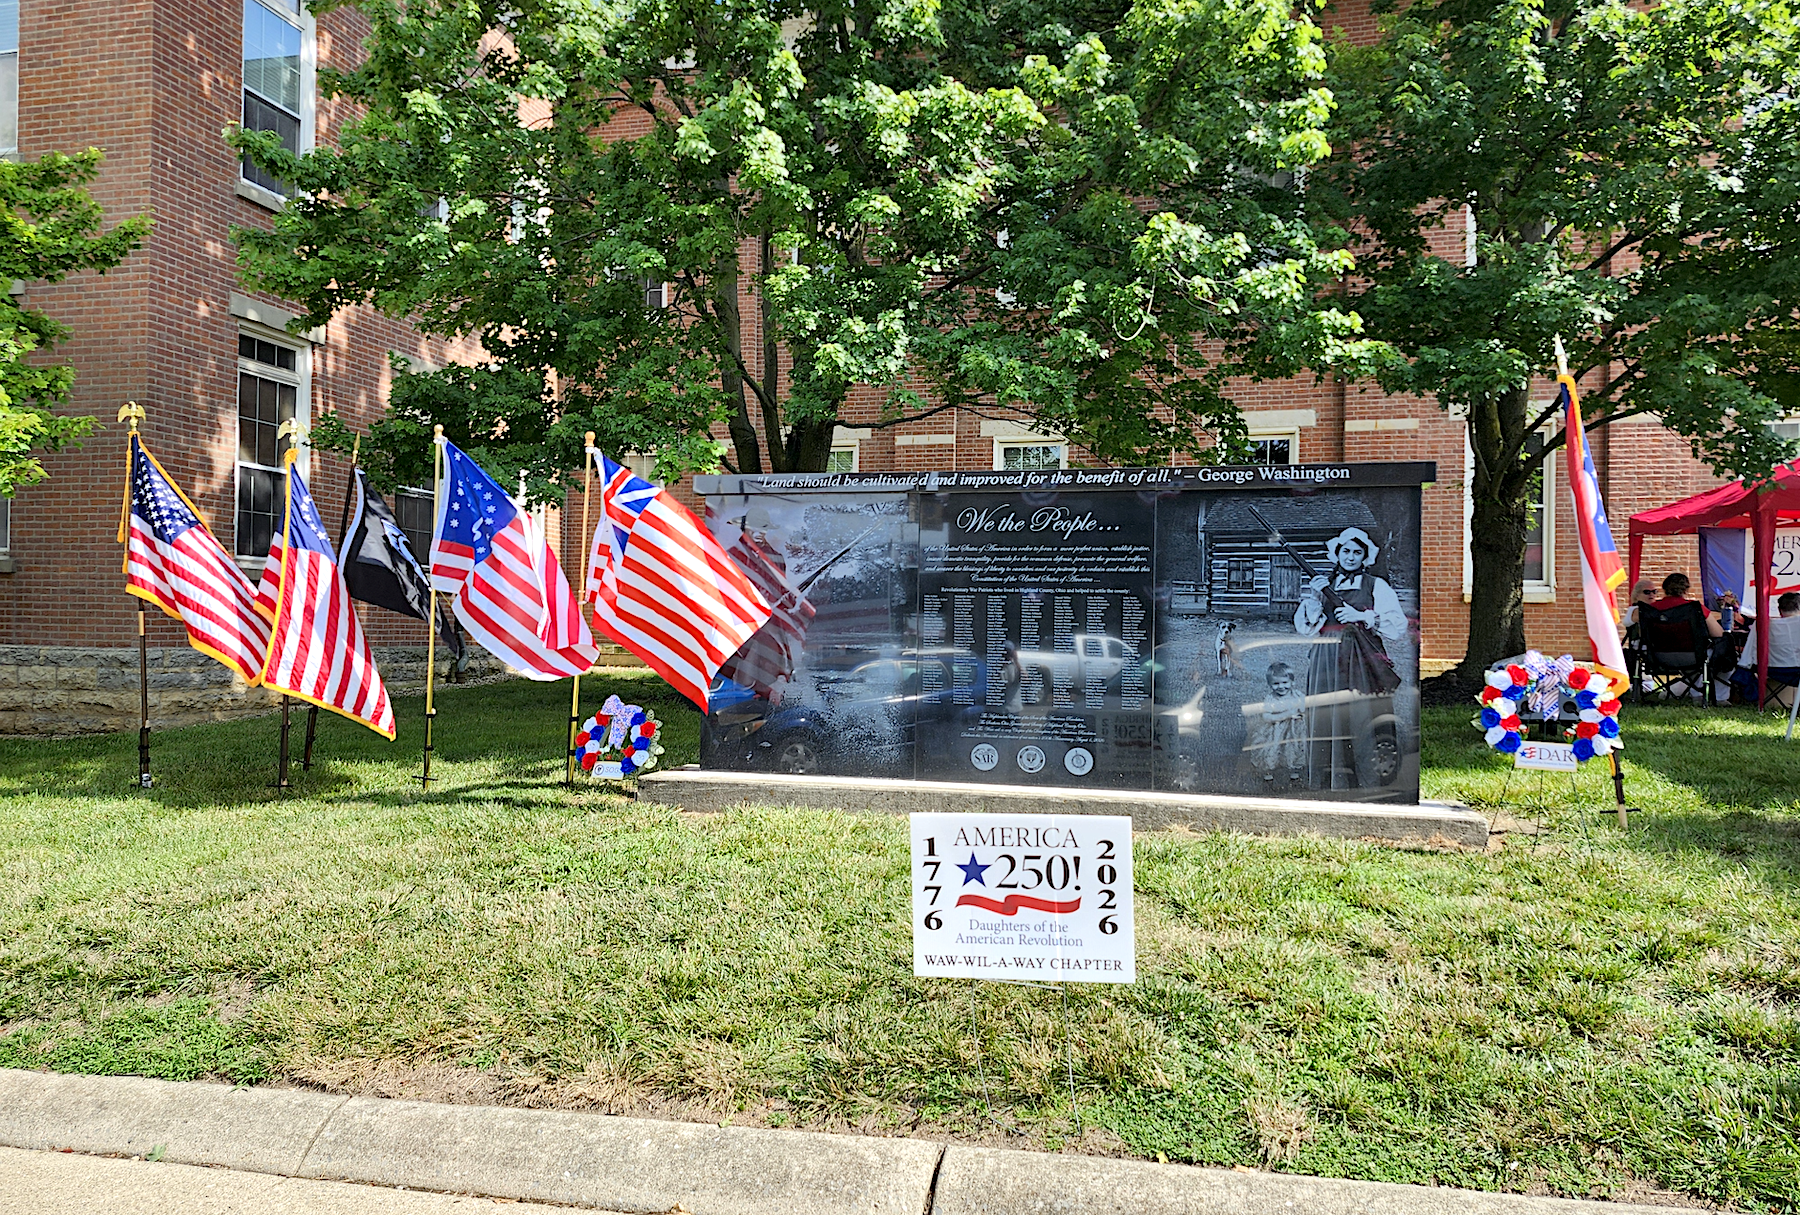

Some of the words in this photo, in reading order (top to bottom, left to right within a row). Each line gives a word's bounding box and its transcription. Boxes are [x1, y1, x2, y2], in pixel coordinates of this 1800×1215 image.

[757, 476, 794, 488] "Land
[798, 475, 842, 488] should
[844, 476, 859, 487] be
[862, 473, 929, 487] cultivated
[931, 473, 954, 486] and
[959, 472, 1024, 489] improved
[1024, 471, 1048, 488] for
[1050, 472, 1072, 484] the
[1076, 470, 1124, 484] benefit
[1128, 470, 1145, 486] of
[1146, 469, 1182, 483] all."
[1198, 468, 1254, 485] George
[1258, 466, 1350, 483] Washington
[956, 504, 1010, 534] We
[997, 512, 1025, 532] the
[924, 546, 930, 554] of
[939, 543, 960, 552] United
[961, 544, 978, 552] States
[978, 546, 986, 554] of
[984, 543, 1010, 552] America
[1036, 544, 1052, 554] form
[1072, 544, 1091, 554] perfect
[992, 556, 1012, 564] provide
[1010, 556, 1020, 564] for
[1072, 556, 1096, 564] promote
[1104, 556, 1127, 565] general
[962, 566, 983, 574] blessings
[984, 566, 991, 574] of
[989, 566, 1004, 574] liberty
[1054, 566, 1078, 574] posterity
[970, 574, 1003, 582] Constitution
[1003, 576, 1010, 584] of
[1018, 574, 1040, 582] United
[1041, 574, 1058, 583] States
[1059, 576, 1067, 584] of
[1066, 573, 1093, 582] America
[974, 754, 994, 764] SAR
[1538, 747, 1574, 763] DAR
[954, 827, 1080, 848] AMERICA
[994, 854, 1082, 891] 250!
[922, 836, 943, 931] 1776
[1096, 840, 1118, 935] 2026
[968, 919, 1031, 934] Daughters
[1034, 920, 1048, 932] of
[1050, 922, 1068, 933] the
[955, 933, 1014, 946] American
[1018, 934, 1083, 947] Revolution
[924, 954, 1046, 969] WAW-WIL-A-WAY
[1050, 958, 1124, 972] CHAPTER
